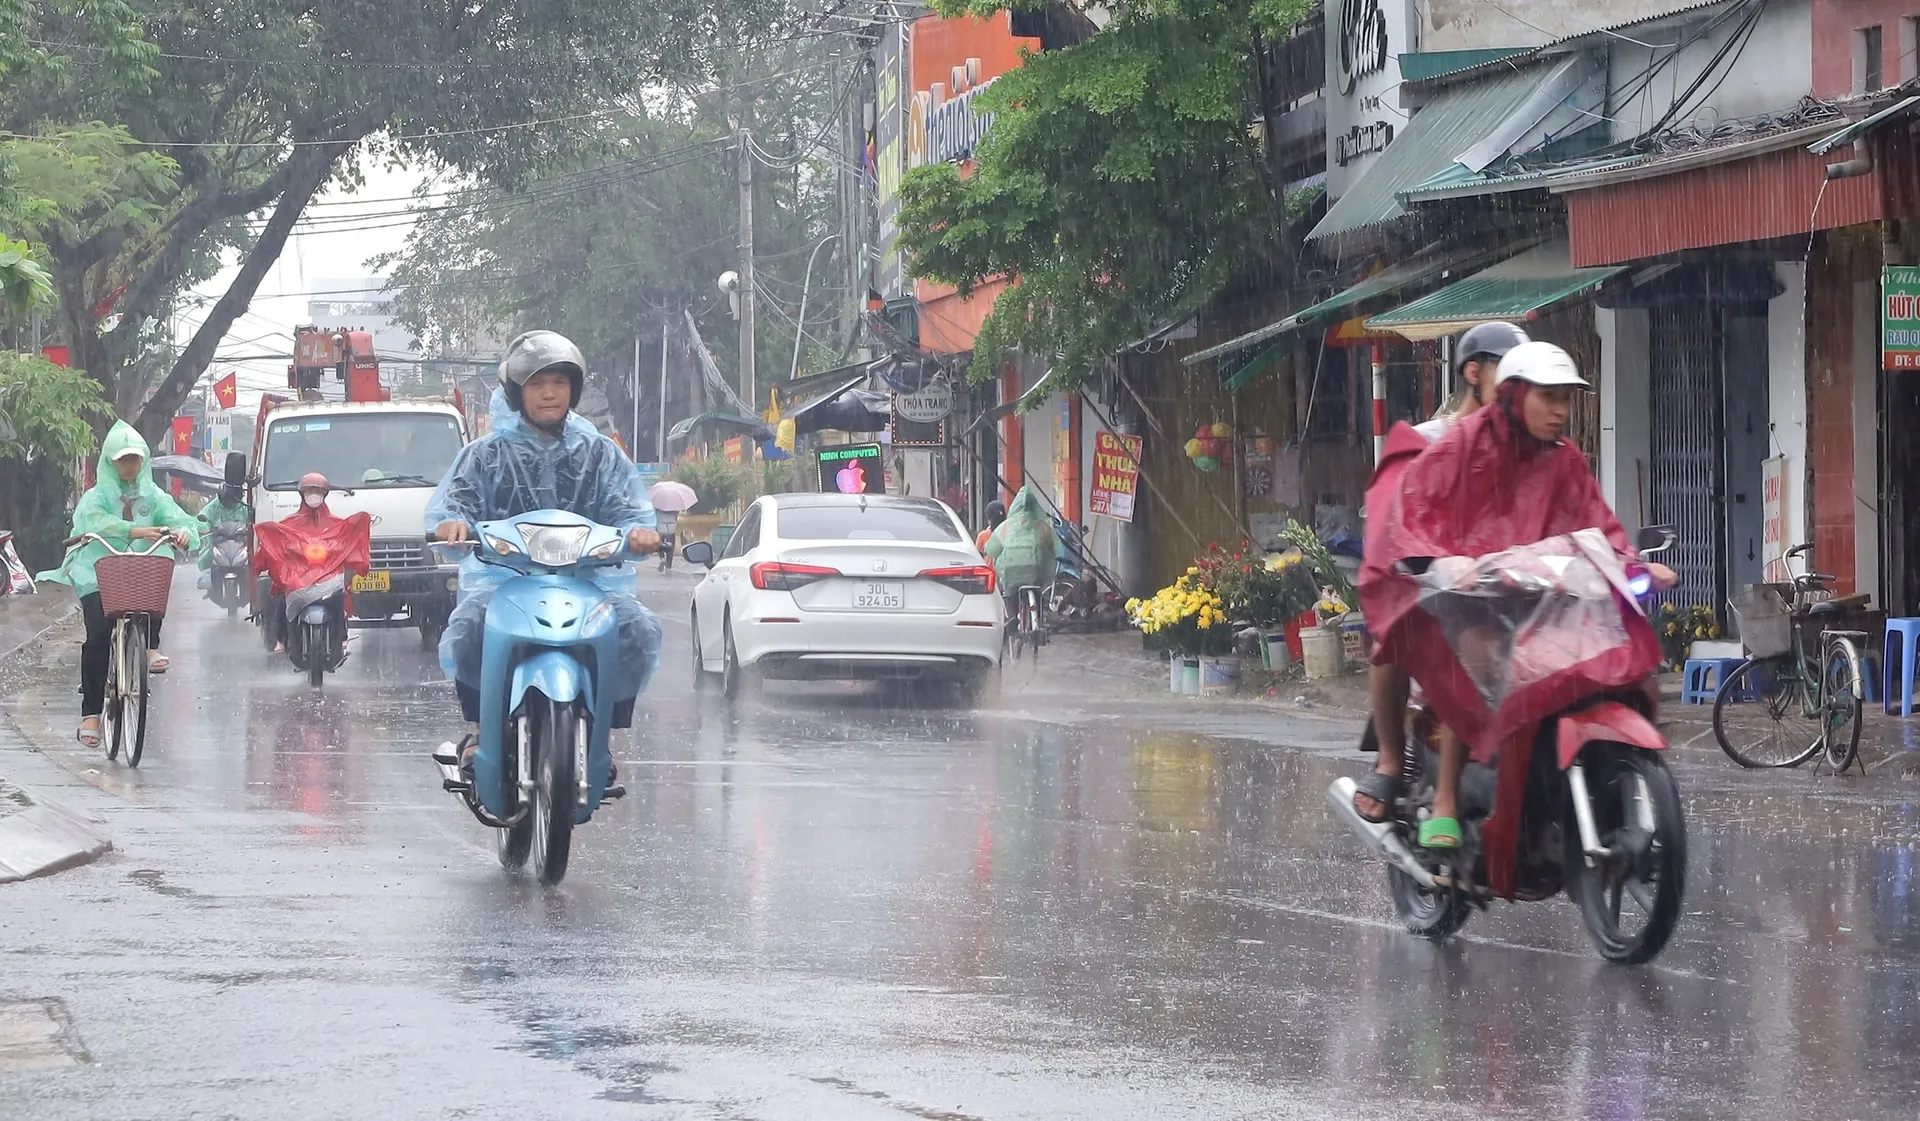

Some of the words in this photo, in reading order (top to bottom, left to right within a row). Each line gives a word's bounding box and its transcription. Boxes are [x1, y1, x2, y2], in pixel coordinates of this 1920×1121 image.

[1887, 290, 1914, 320] HÚT
[1888, 329, 1909, 345] RAU
[840, 448, 877, 459] COMPUTER
[1099, 473, 1132, 494] NHÀ
[867, 584, 889, 595] 30L
[858, 595, 898, 607] 924.05
